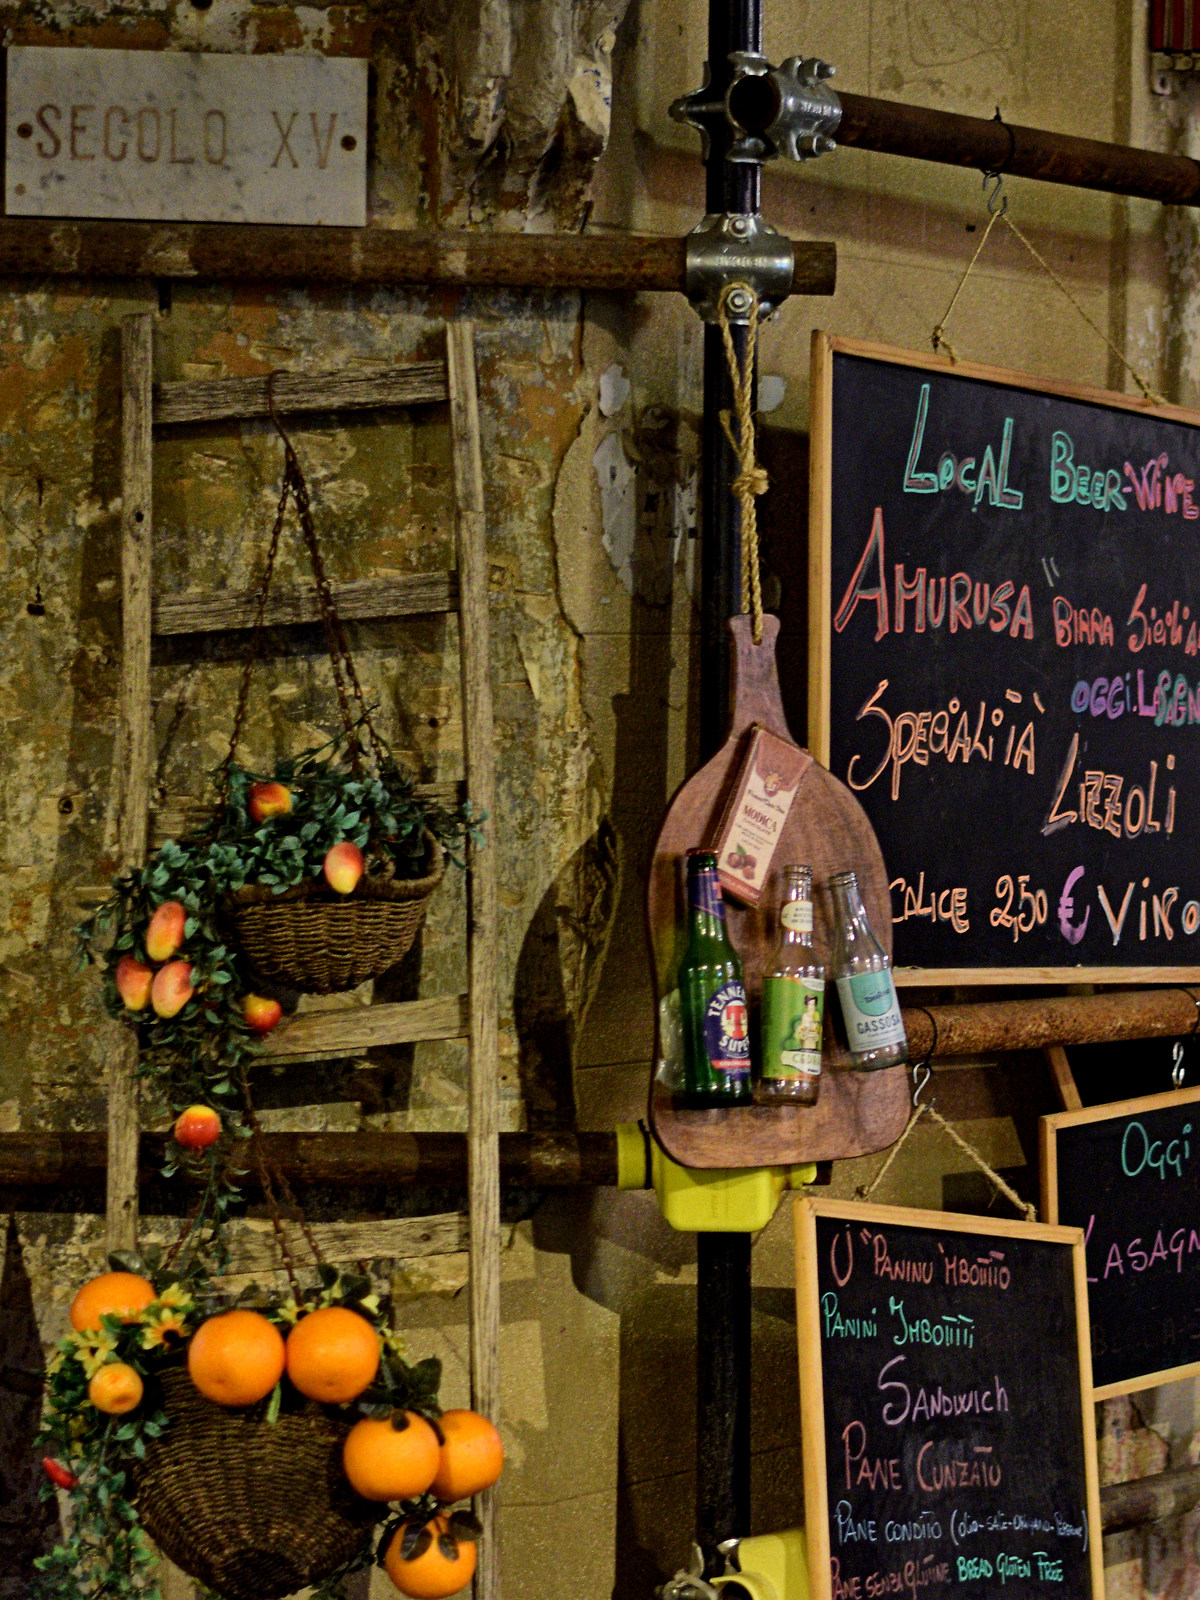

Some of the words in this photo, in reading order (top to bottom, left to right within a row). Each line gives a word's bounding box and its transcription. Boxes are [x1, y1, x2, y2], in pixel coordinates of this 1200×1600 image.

[35, 103, 227, 166] SECOLO
[270, 109, 338, 169] XV
[989, 873, 1049, 943] 2,50
[1057, 864, 1090, 946] €
[842, 1420, 902, 1491] PANE
[834, 1500, 877, 1546] PANE
[956, 1556, 993, 1582] BREAD
